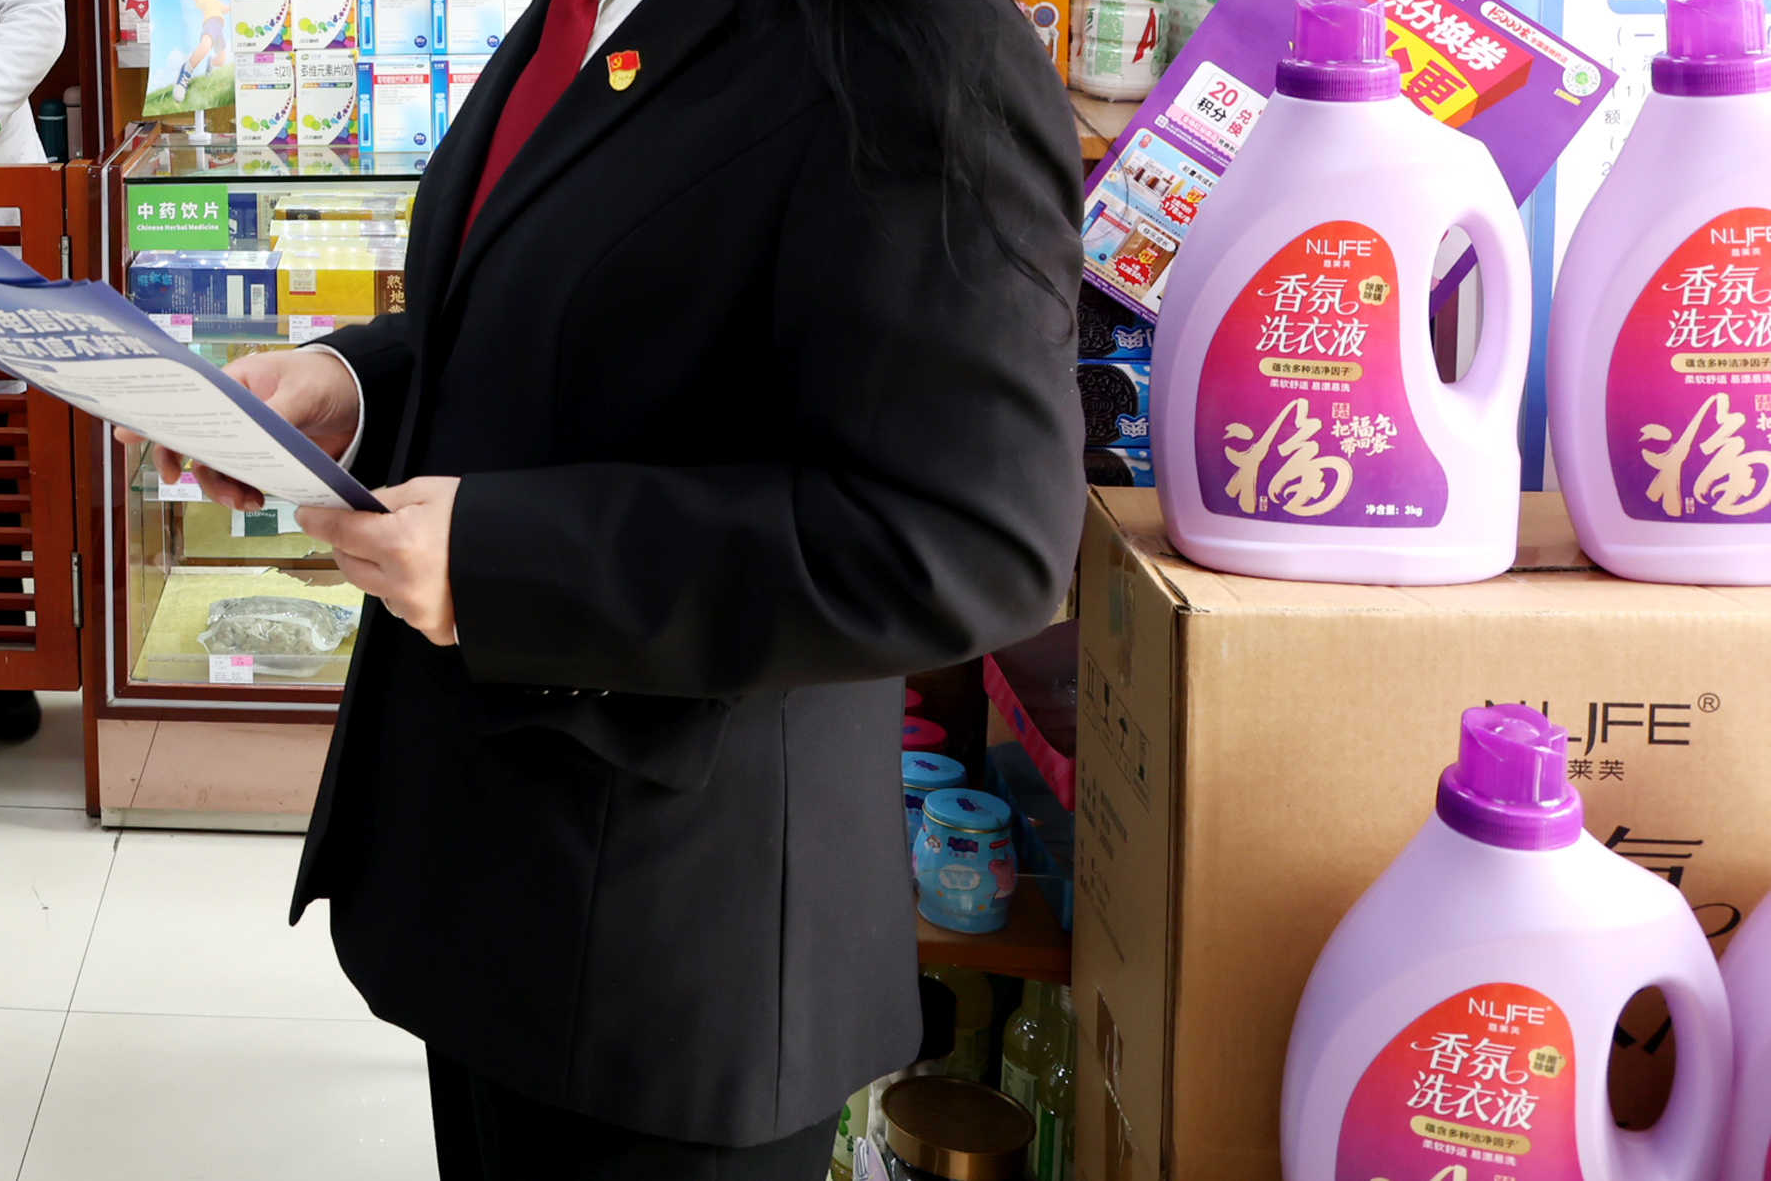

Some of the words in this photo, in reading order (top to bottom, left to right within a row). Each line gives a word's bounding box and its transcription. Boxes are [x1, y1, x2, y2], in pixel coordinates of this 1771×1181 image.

[1207, 80, 1240, 107] 20
[1196, 96, 1228, 123] 积分
[1226, 108, 1254, 138] 兑换
[137, 202, 219, 220] 中药饮片
[136, 224, 164, 232] Chinese
[165, 223, 188, 231] Herbal
[188, 223, 220, 231] Medicine
[1258, 273, 1360, 316] 香氛
[1255, 314, 1370, 359] 洗衣液
[1410, 1031, 1528, 1086] 香氛
[1406, 1070, 1540, 1131] 洗衣液
